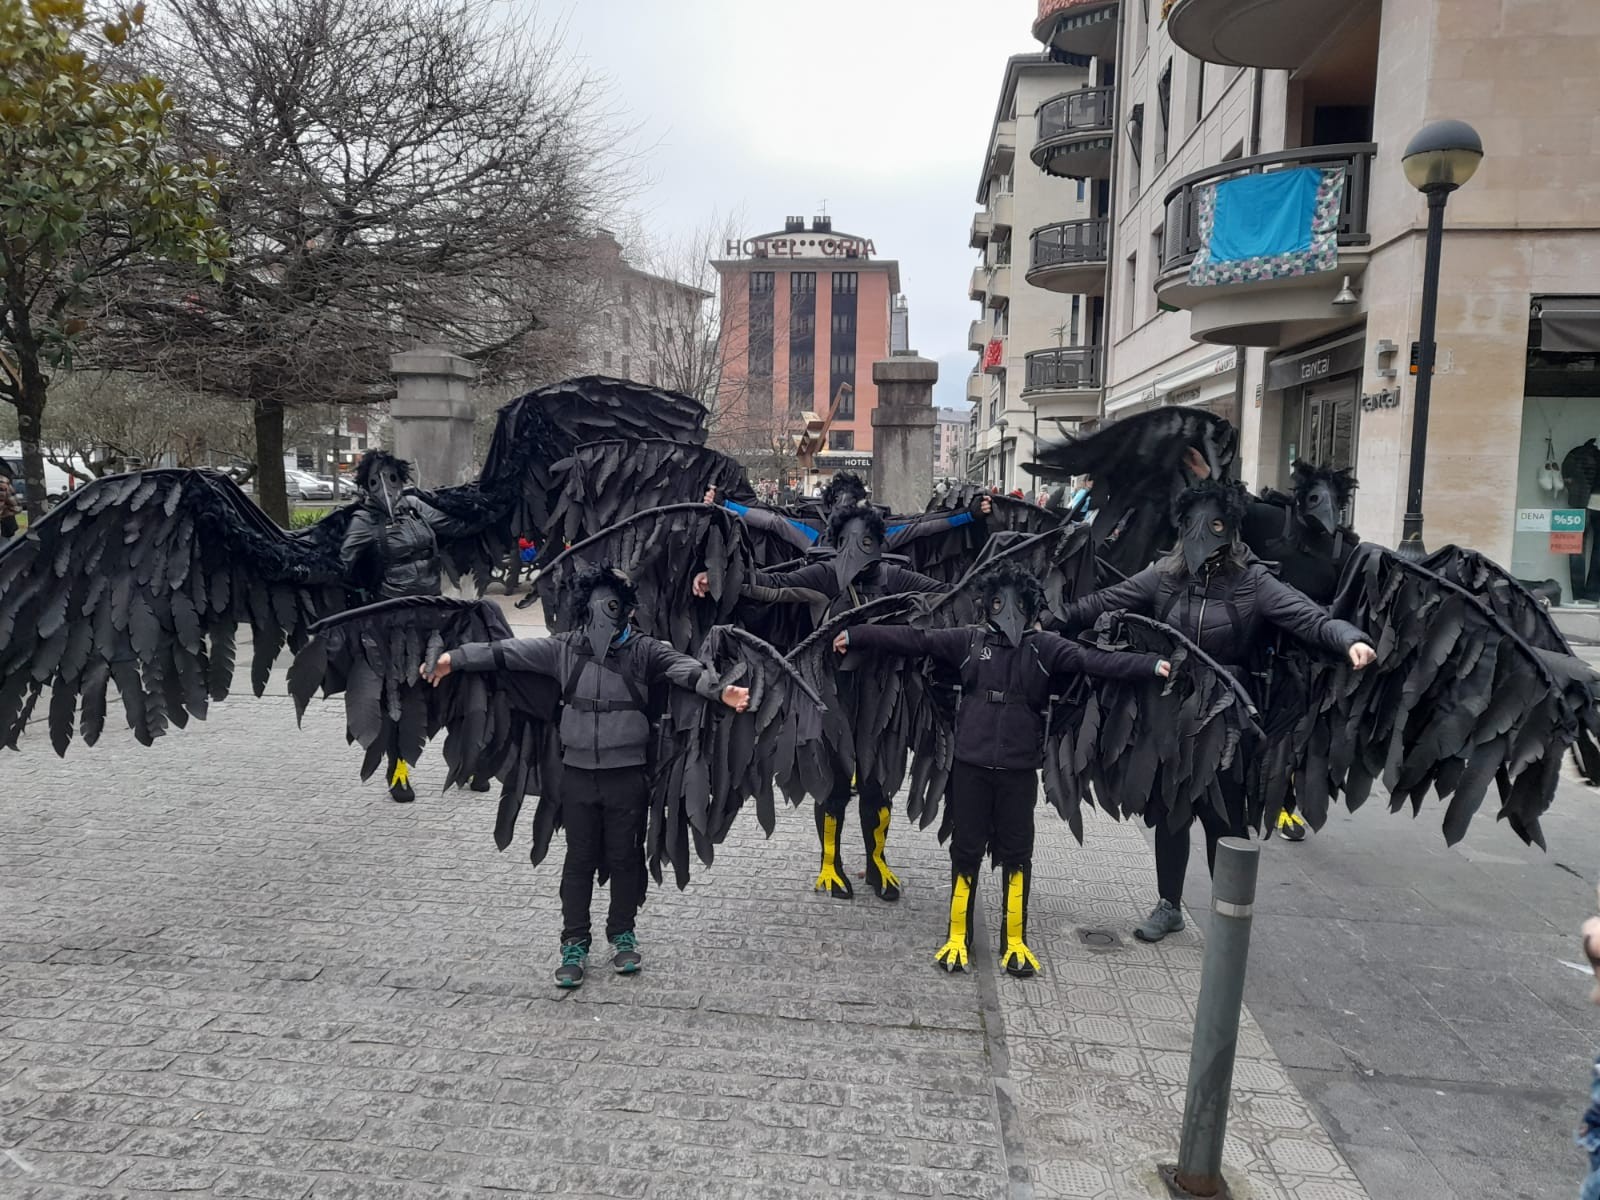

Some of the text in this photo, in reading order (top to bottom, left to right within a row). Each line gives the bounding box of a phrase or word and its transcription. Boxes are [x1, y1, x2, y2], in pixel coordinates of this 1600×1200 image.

[726, 238, 877, 256] HOTEL ORIA
[1520, 512, 1582, 525] DENA %50
